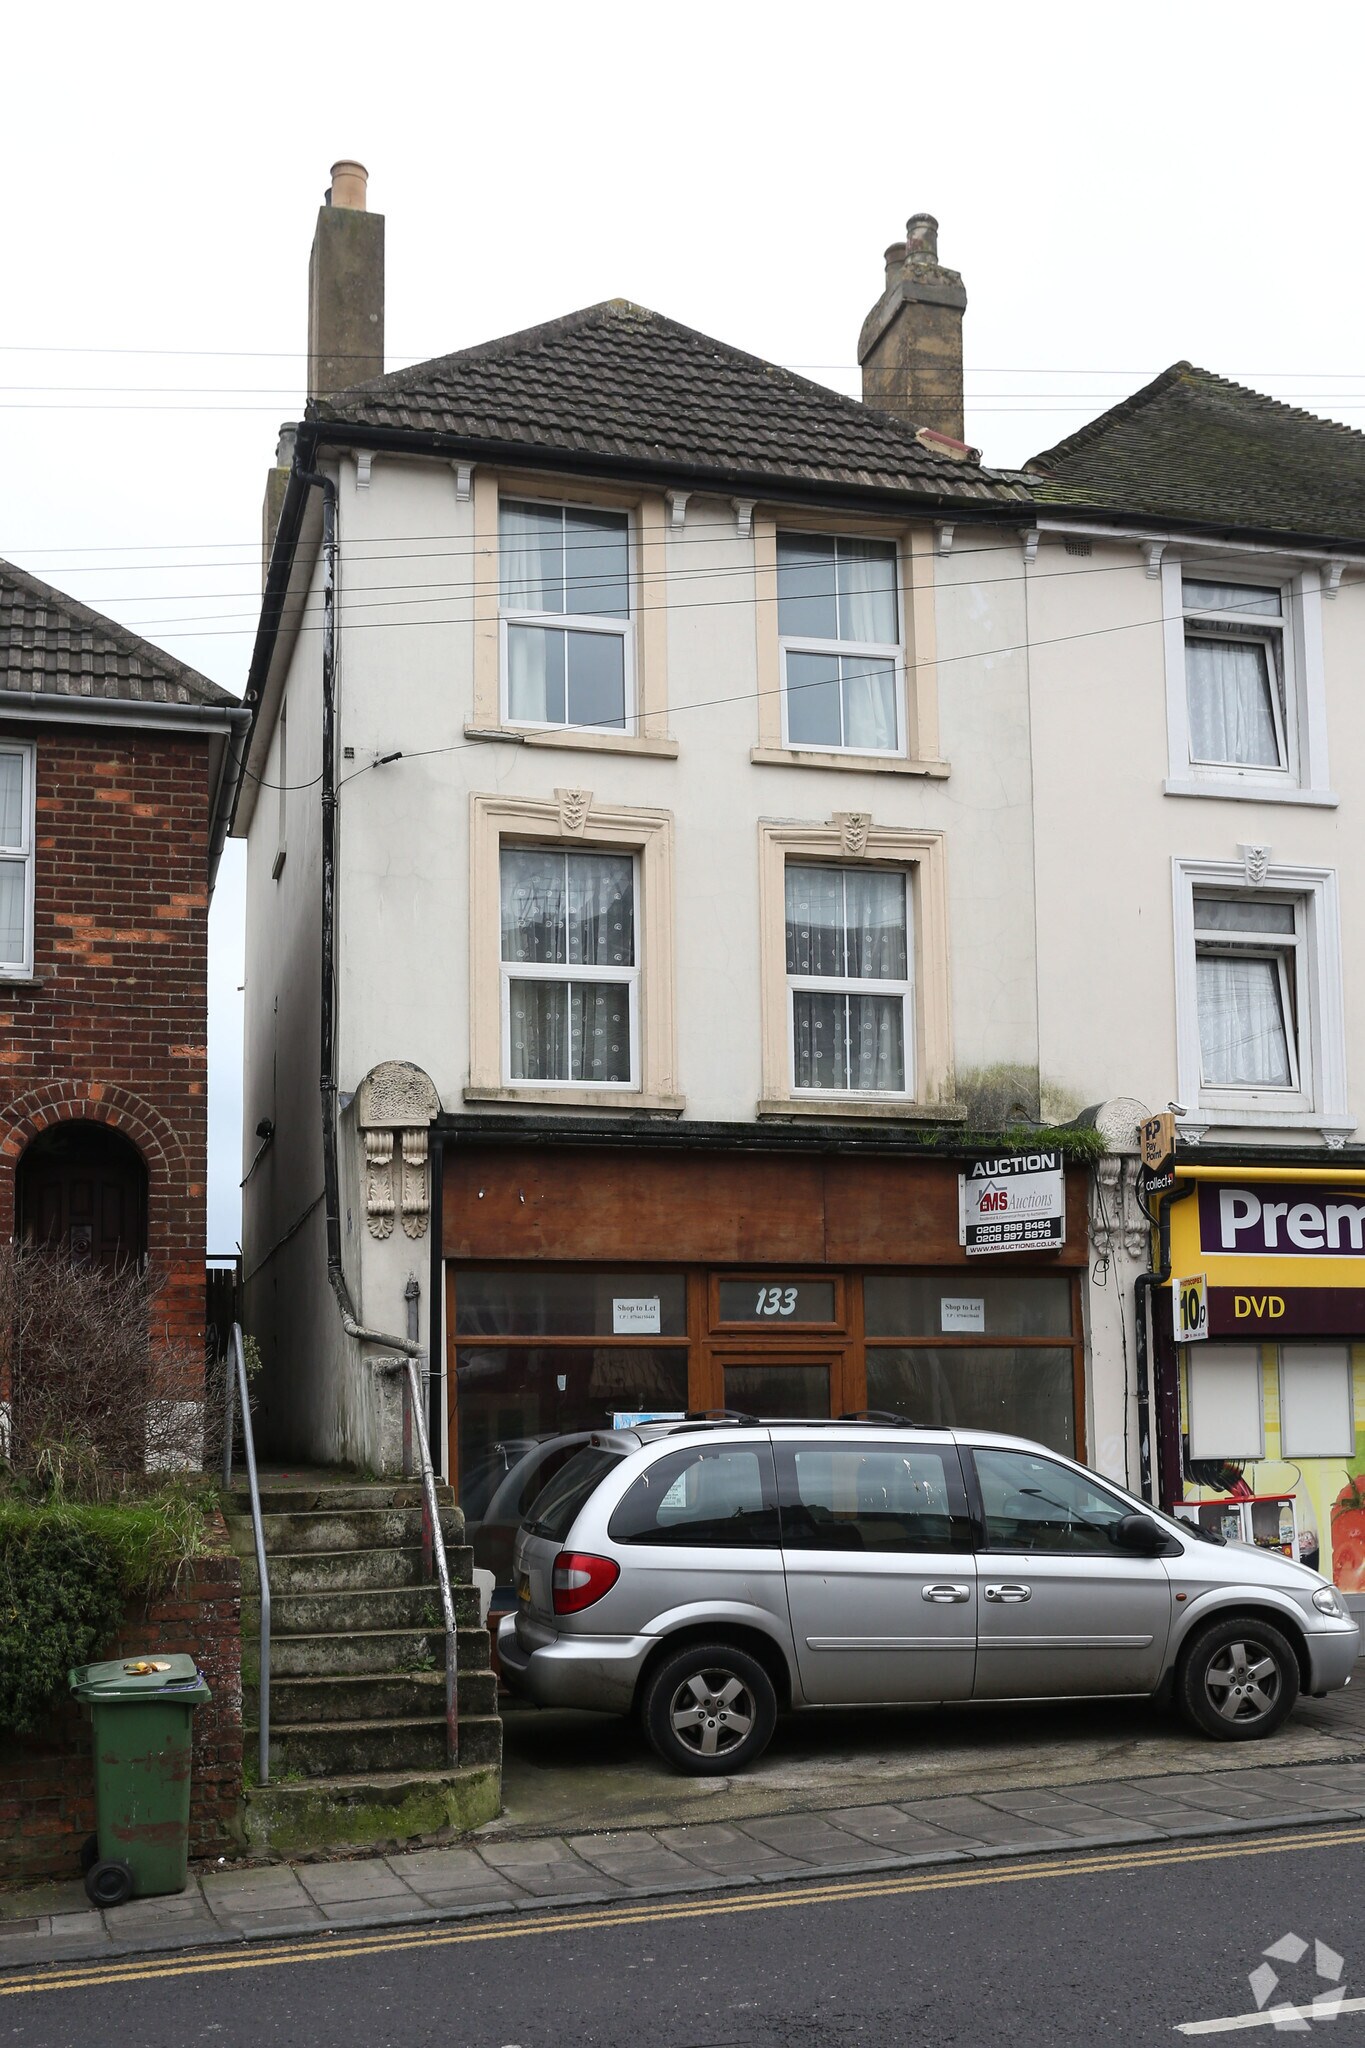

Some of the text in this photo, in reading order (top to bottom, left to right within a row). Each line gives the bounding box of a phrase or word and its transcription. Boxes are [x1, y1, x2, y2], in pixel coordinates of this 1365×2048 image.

[1146, 1142, 1157, 1151] Pay
[1146, 1149, 1162, 1161] Point
[971, 1153, 1055, 1177] AUCTION
[1008, 1191, 1052, 1209] Auctions
[1219, 1189, 1365, 1249] Prem
[976, 1220, 1051, 1234] 0208 998 8464
[976, 1229, 1051, 1243] 0208 997 5878
[970, 1241, 1057, 1253] WWW.MSAUCTIONS.CO.UK
[617, 1304, 635, 1312] Shop
[756, 1287, 798, 1315] 133
[1234, 1295, 1285, 1318] DVD
